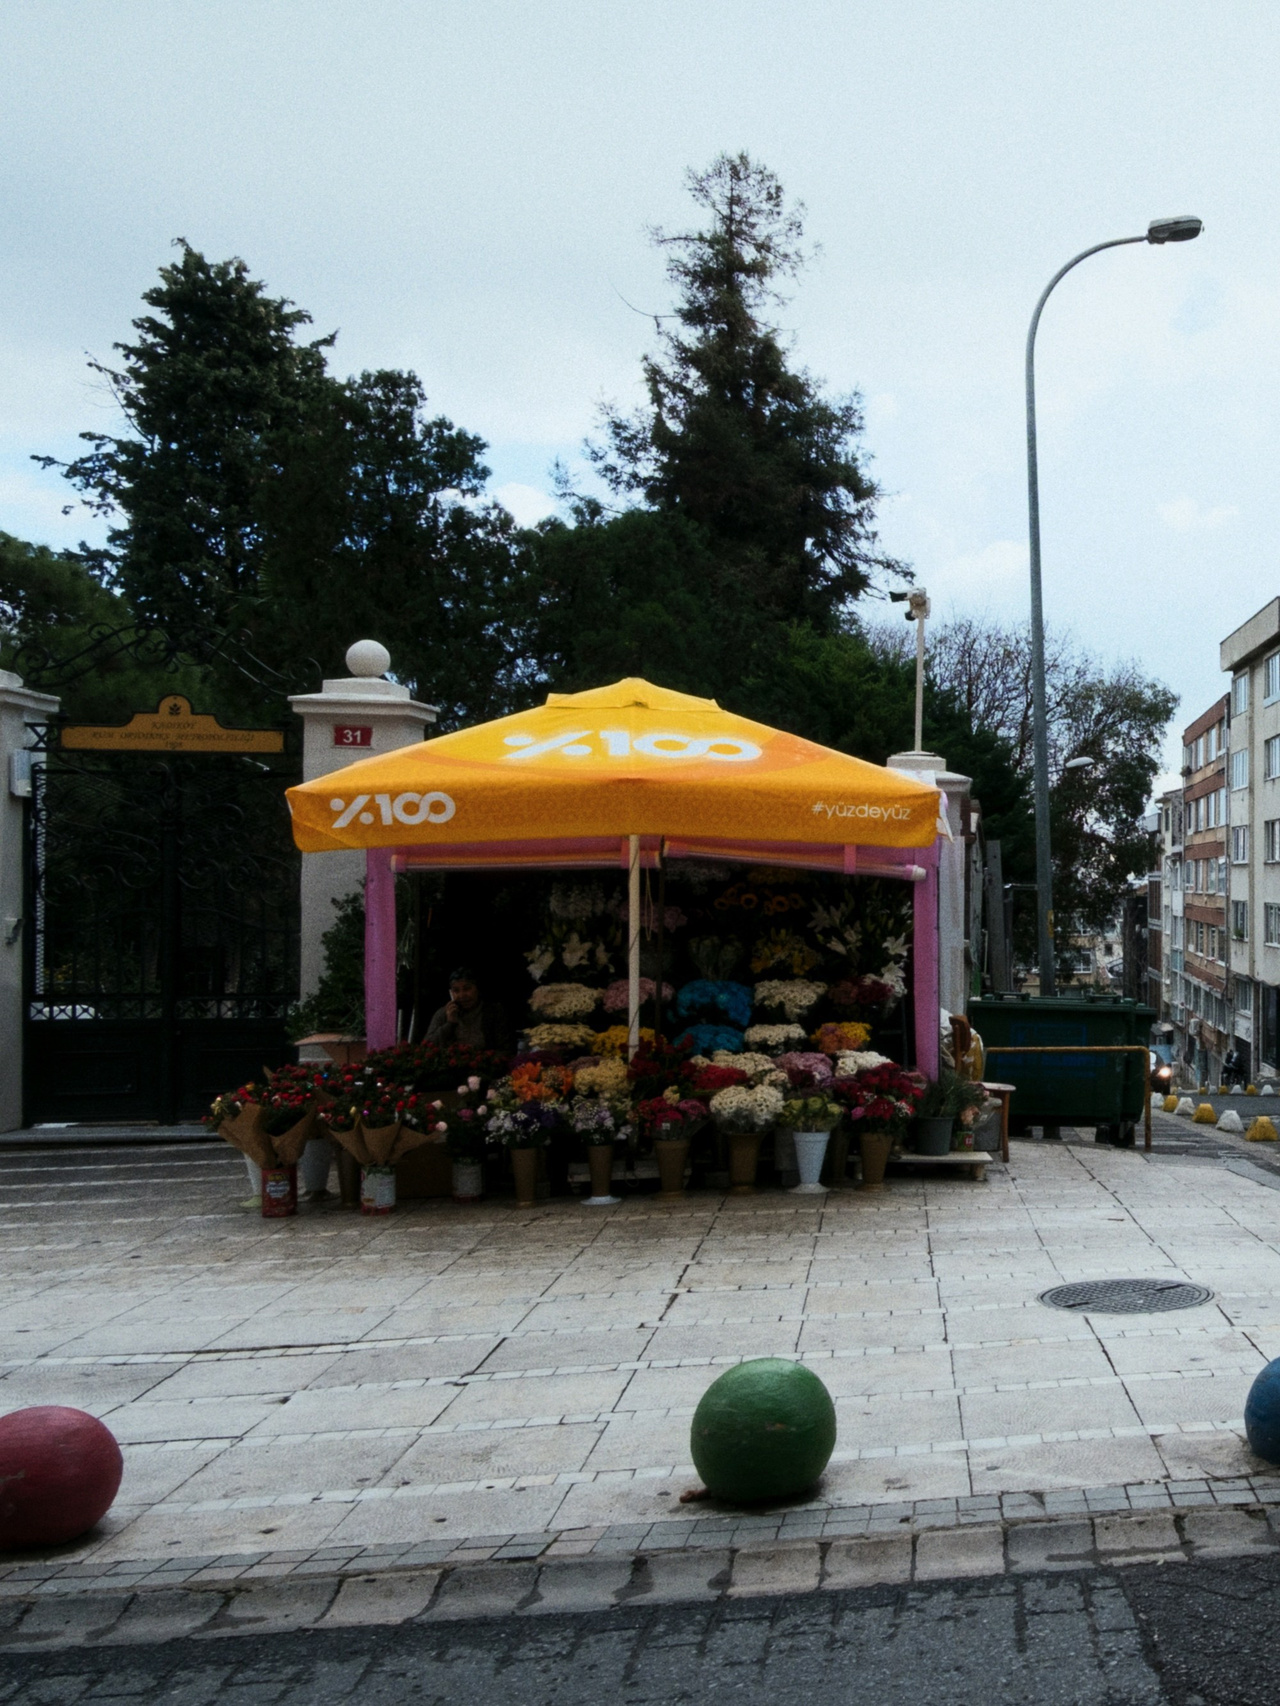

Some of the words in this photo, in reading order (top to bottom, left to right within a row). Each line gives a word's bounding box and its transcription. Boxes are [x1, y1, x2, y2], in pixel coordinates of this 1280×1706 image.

[342, 729, 362, 744] 31
[501, 729, 763, 762] %100
[329, 790, 457, 829] %100
[811, 799, 911, 822] #yüzdeyüz
